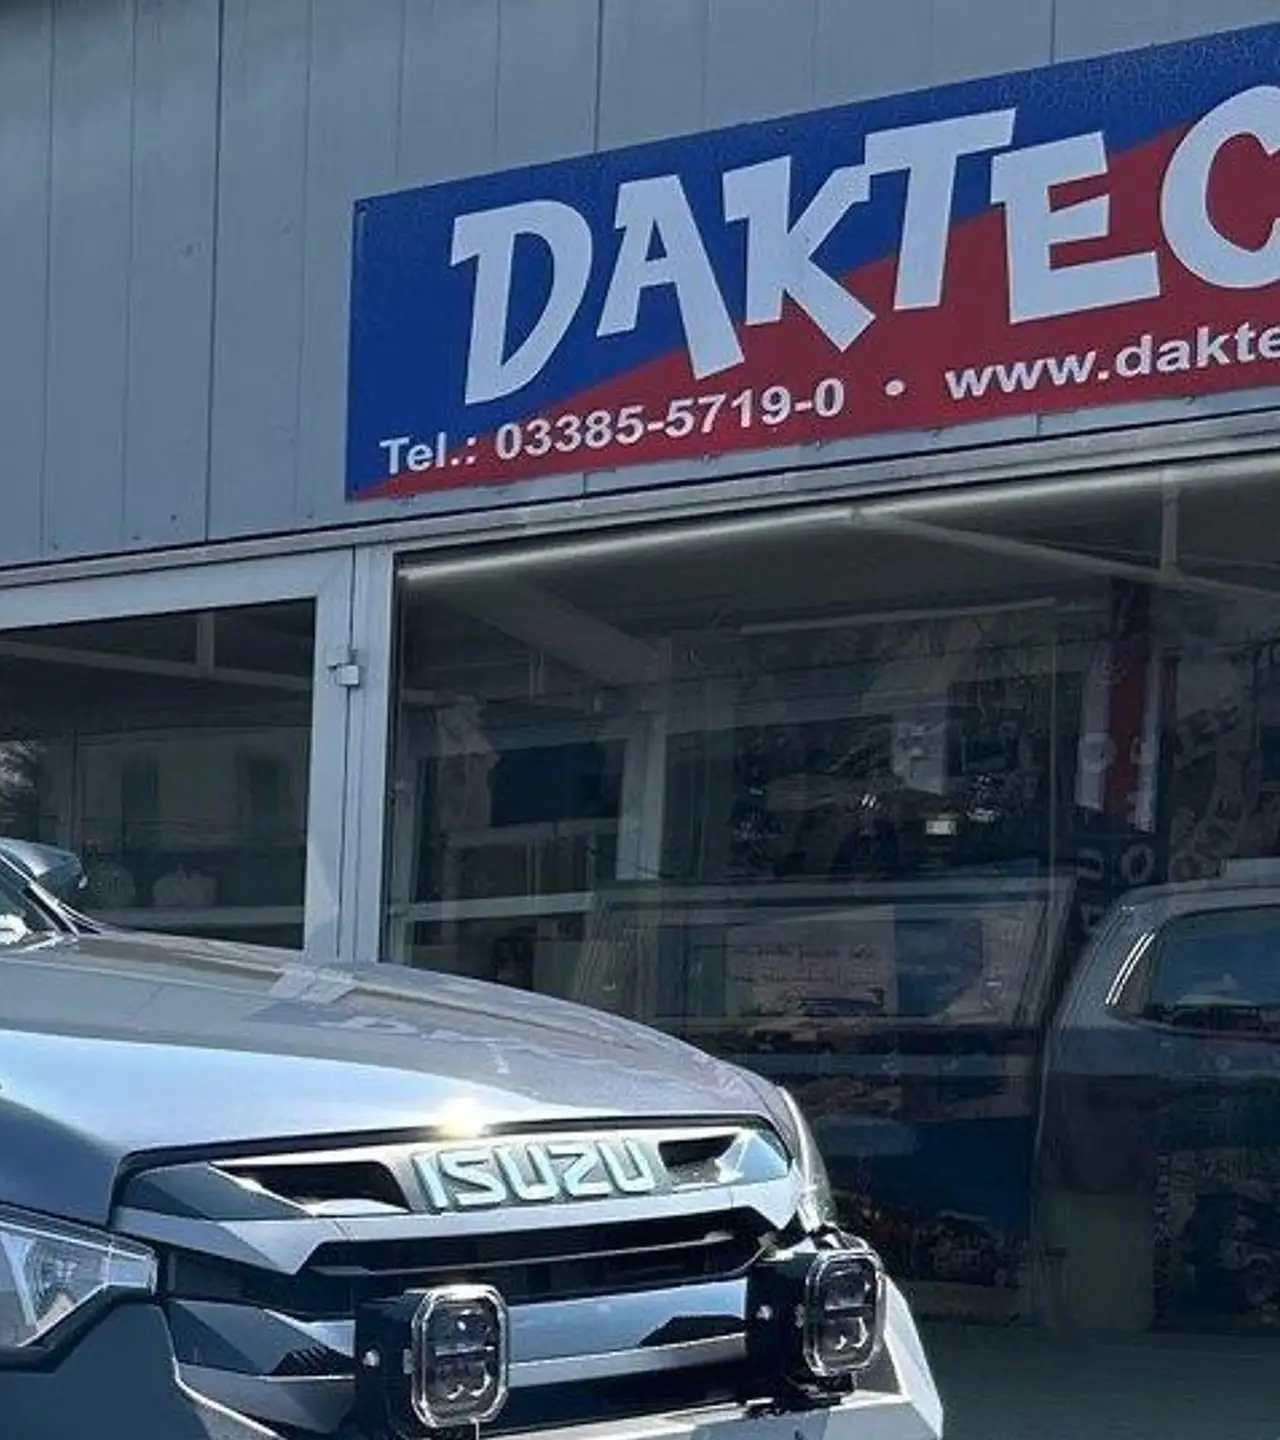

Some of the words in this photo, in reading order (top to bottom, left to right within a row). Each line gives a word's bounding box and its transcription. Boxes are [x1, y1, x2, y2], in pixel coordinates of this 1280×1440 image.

[448, 84, 1280, 406] DAKTEC
[379, 432, 477, 475] Tel.:
[495, 378, 845, 460] 03385-5719-0
[945, 321, 1280, 402] www.dakte
[408, 1138, 657, 1211] ISUZU
